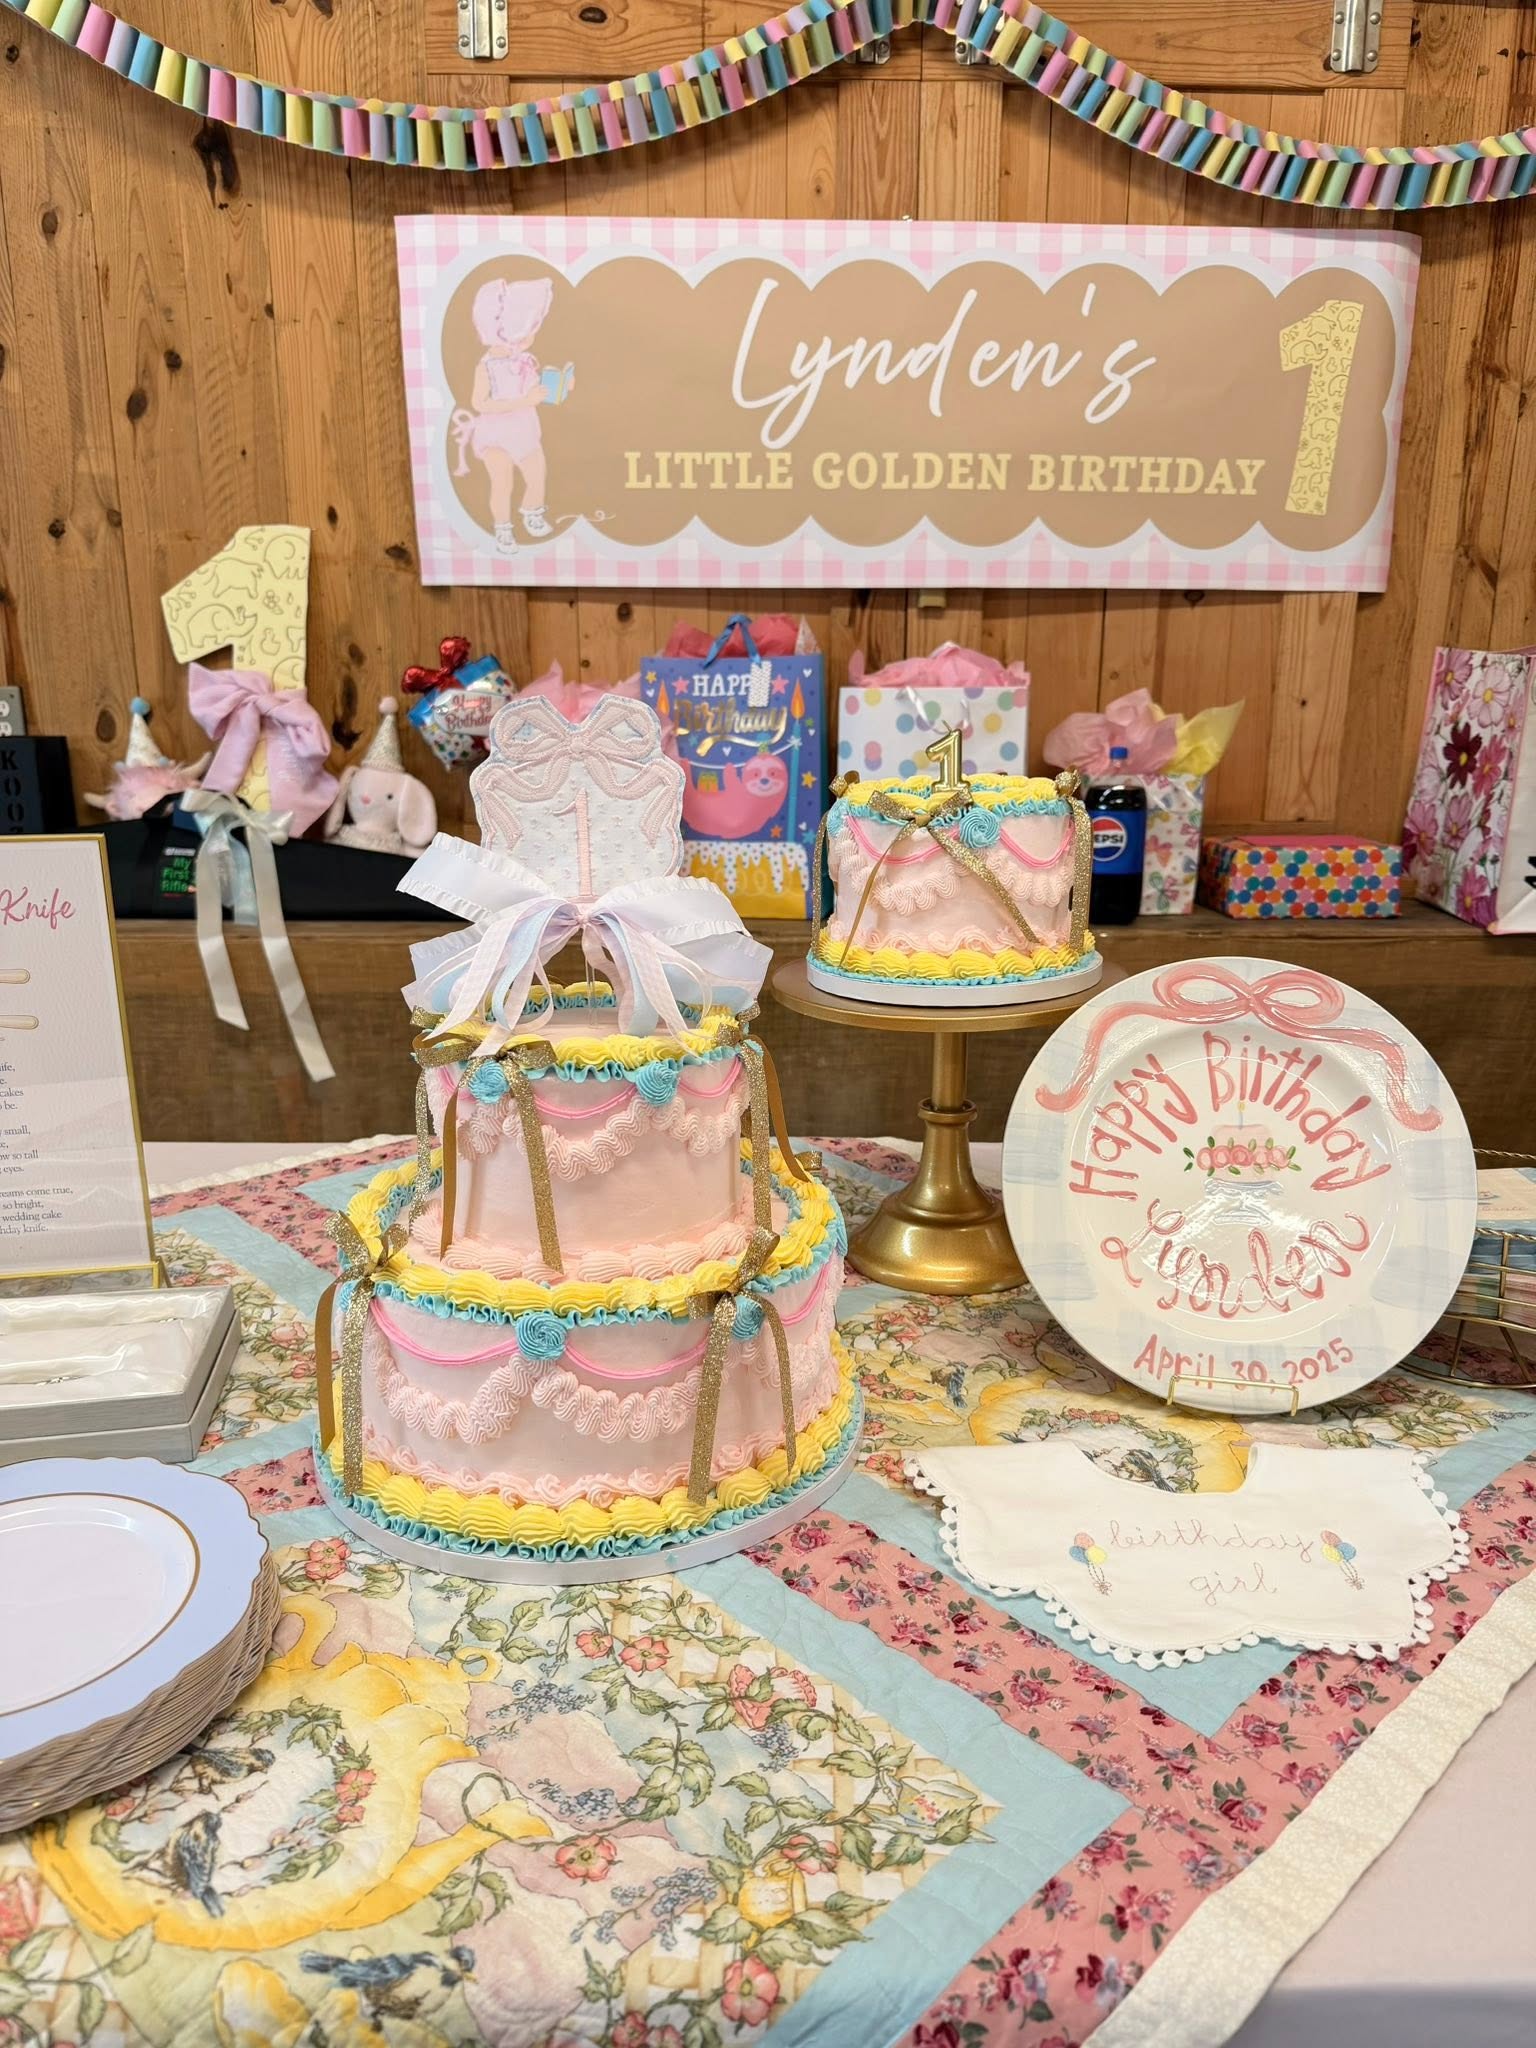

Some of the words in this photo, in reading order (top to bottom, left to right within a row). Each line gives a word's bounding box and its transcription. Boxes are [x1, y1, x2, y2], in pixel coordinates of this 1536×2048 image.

[732, 278, 1157, 449] Lynden's
[1279, 300, 1363, 515] 1
[624, 451, 794, 490] LITTLE
[812, 452, 1012, 491] GOLDEN
[1027, 455, 1267, 496] BIRTHDAY
[692, 673, 753, 697] HAPP
[445, 710, 492, 732] Birthda
[1093, 833, 1124, 844] EPSI
[0, 886, 76, 930] Knife
[1069, 1053, 1199, 1201] Happy
[1202, 1030, 1392, 1193] Birthday
[24, 1149, 39, 1159] tall
[2, 1211, 40, 1221] wedding
[41, 1210, 63, 1219] cake
[1101, 1199, 1370, 1319] Lynden
[1133, 1334, 1215, 1390] April
[1281, 1337, 1354, 1386] 2025
[1106, 1519, 1315, 1563] birthday
[1188, 1562, 1278, 1606] girl
